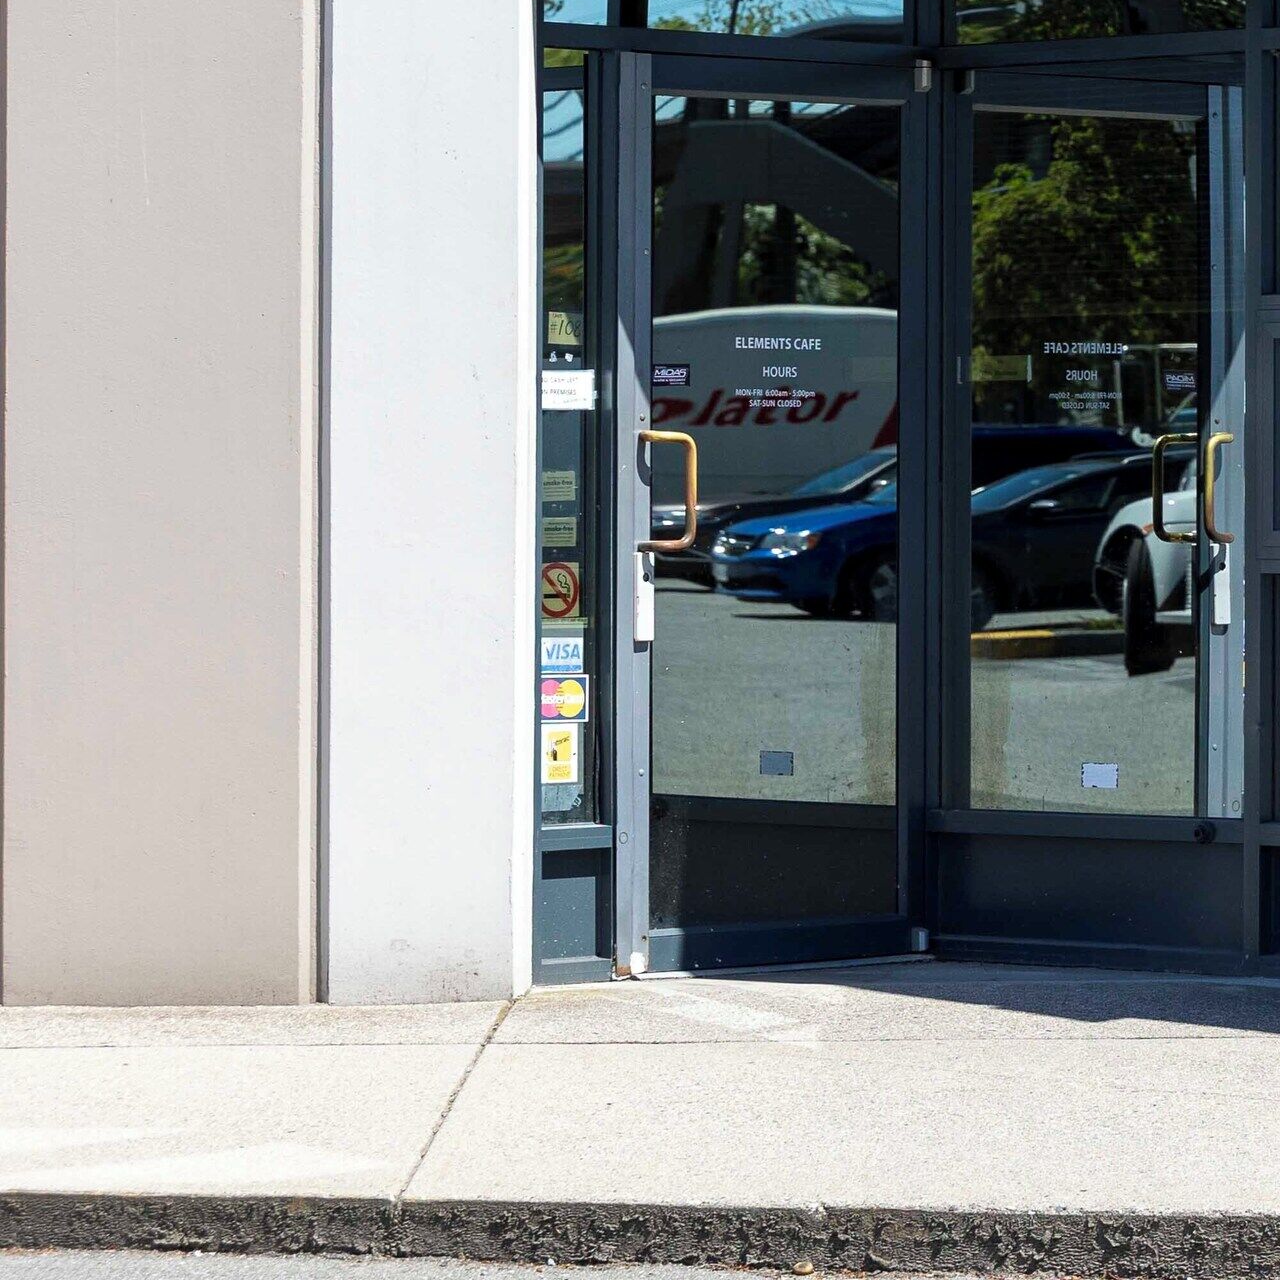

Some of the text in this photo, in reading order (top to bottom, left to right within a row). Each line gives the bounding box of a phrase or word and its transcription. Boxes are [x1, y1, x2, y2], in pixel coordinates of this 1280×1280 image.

[735, 336, 822, 351] ELEMENTS CAFE
[654, 368, 687, 378] MIDAS
[762, 366, 797, 378] HOURS
[735, 388, 763, 398] MON-FRI
[765, 389, 788, 398] 6:00am
[792, 389, 816, 399] 5:00pm
[749, 399, 802, 408] SAT-SUN CLOSED
[545, 643, 581, 660] VISA
